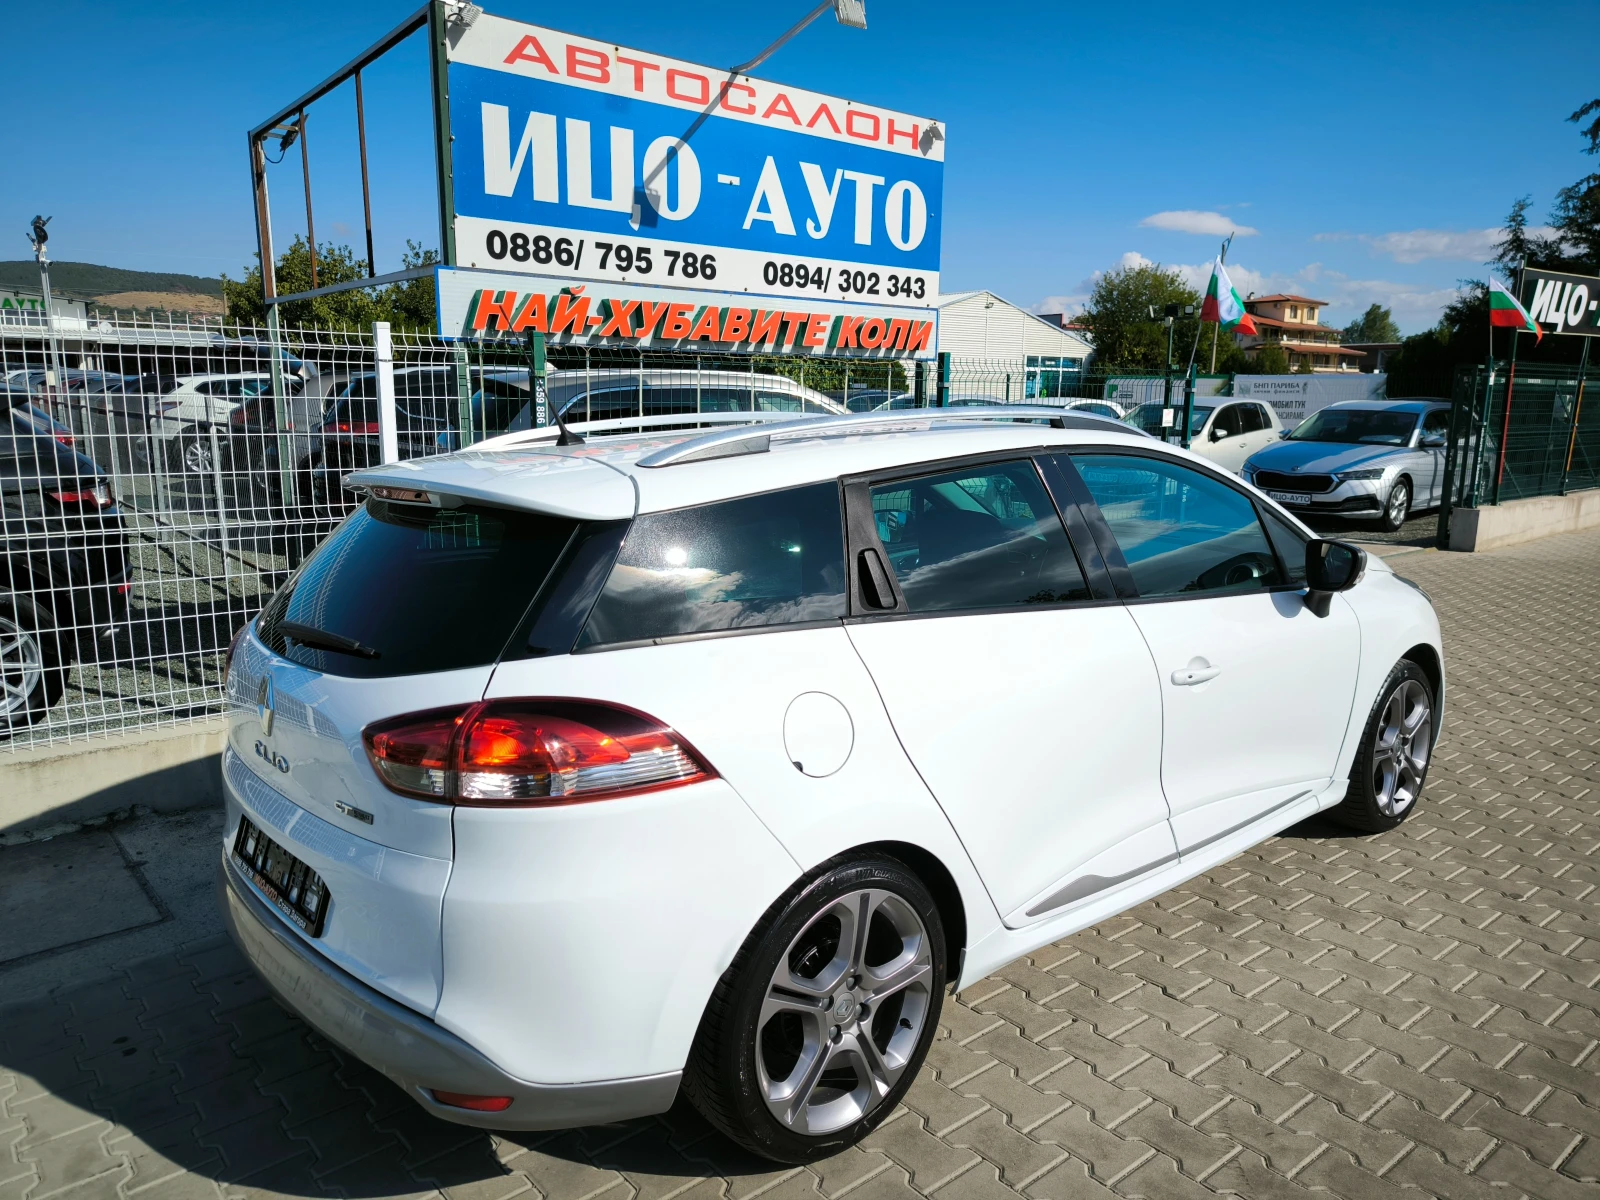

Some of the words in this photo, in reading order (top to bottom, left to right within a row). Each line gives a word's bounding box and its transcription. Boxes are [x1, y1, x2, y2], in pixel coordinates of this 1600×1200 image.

[502, 34, 920, 150] АВТОСАЛОН
[485, 229, 584, 271] 0886/
[595, 241, 653, 275] 795
[663, 250, 717, 280] 786
[763, 261, 832, 293] 0894/
[838, 269, 880, 295] 302
[886, 275, 926, 299] 343
[472, 285, 831, 347] НАЙ-ХУБАВИТЕ
[836, 315, 933, 351] КОЛИ
[1530, 279, 1600, 332] ИЦО-
[536, 406, 545, 424] 886
[254, 740, 290, 773] CLIO
